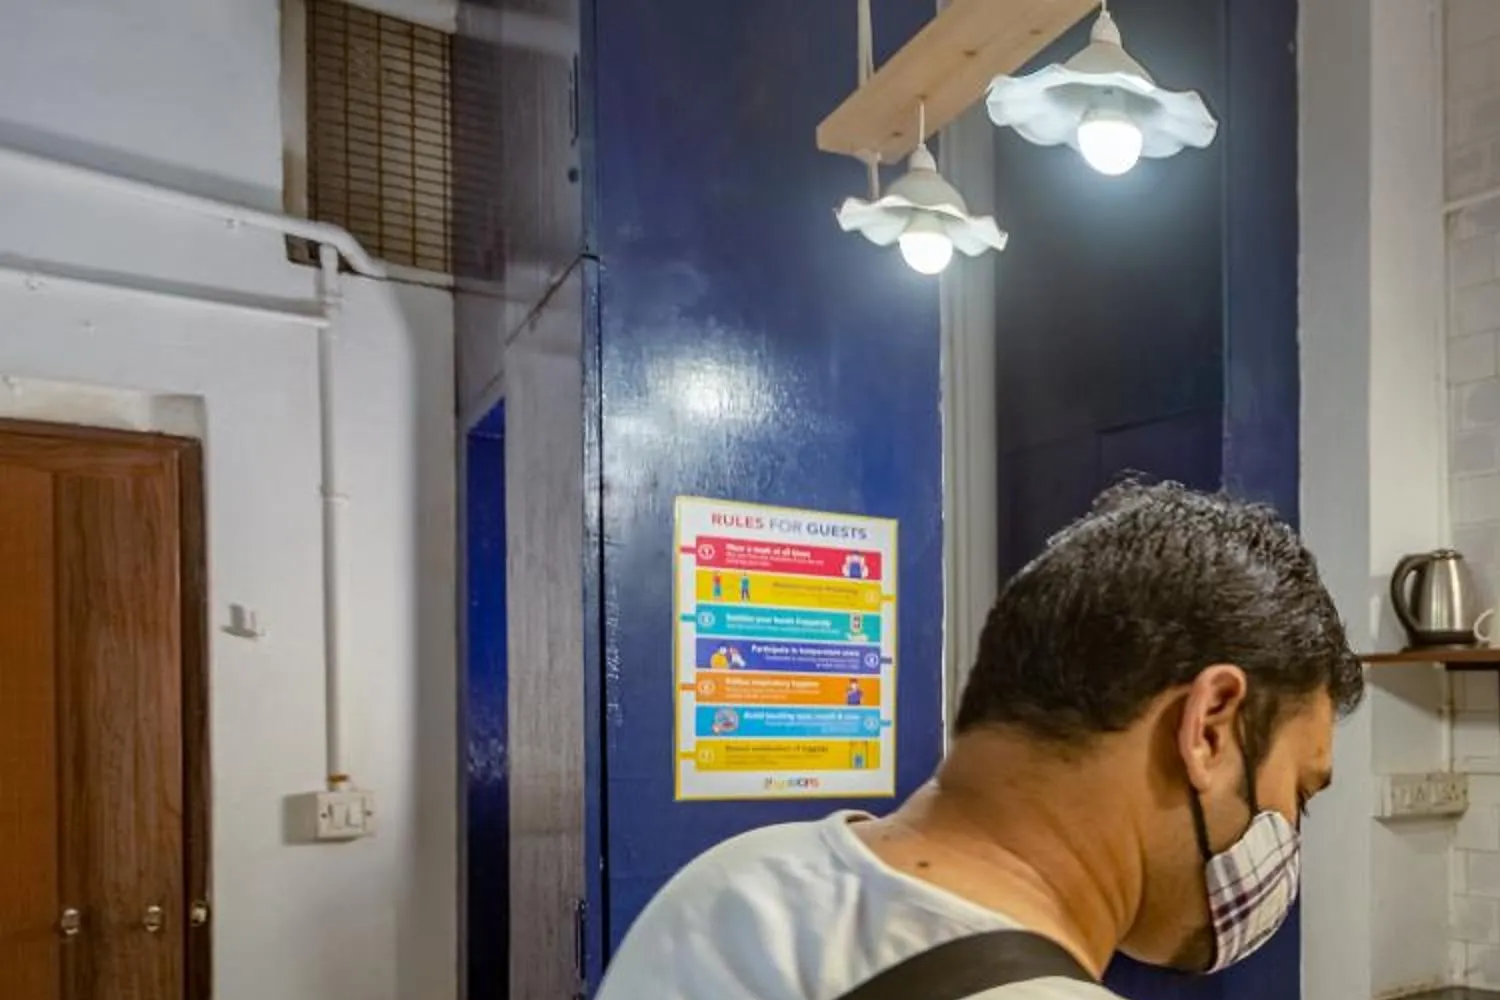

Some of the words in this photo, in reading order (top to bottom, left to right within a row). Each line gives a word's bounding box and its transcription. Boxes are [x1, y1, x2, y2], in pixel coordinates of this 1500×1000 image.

[711, 511, 765, 530] RULES
[769, 517, 802, 535] FOR
[806, 521, 868, 540] GUESTS
